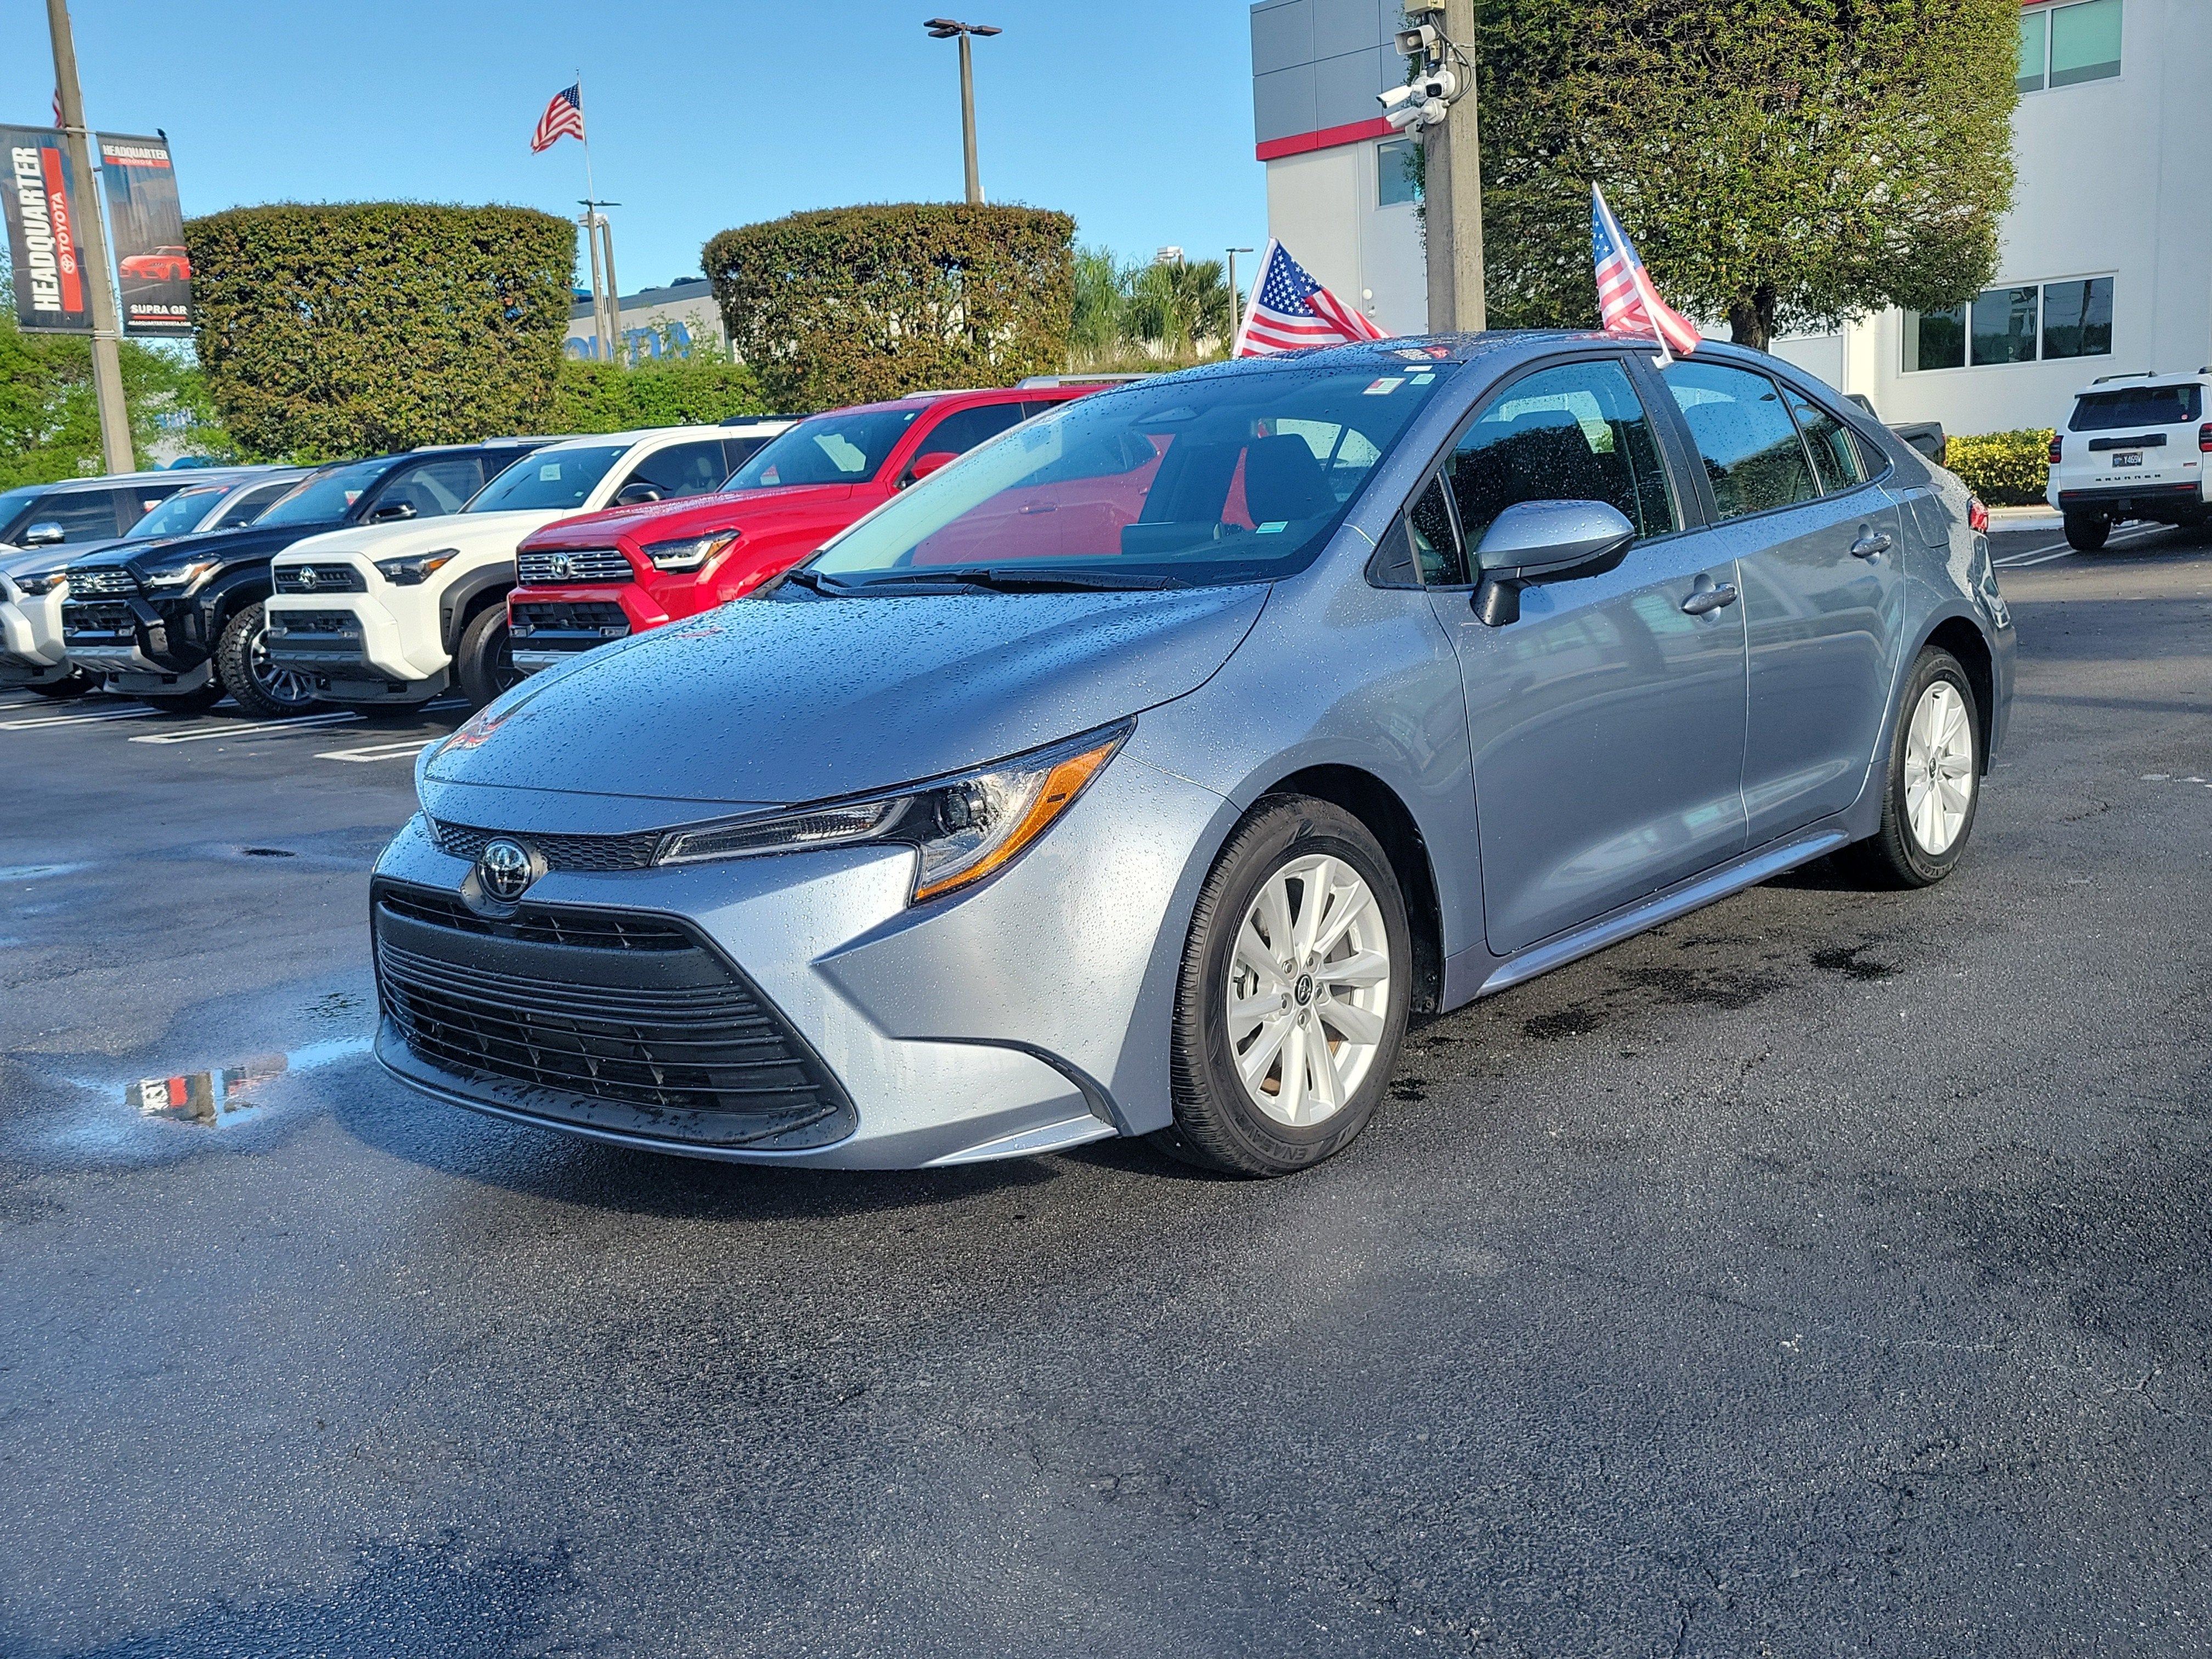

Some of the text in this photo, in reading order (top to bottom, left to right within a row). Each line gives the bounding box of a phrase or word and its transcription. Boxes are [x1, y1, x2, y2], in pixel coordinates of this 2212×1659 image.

[102, 144, 168, 160] HEADQUARTER
[12, 146, 62, 312] HEADQUARTER
[50, 191, 70, 255] TOYOTA
[130, 304, 188, 315] SUPRA GR
